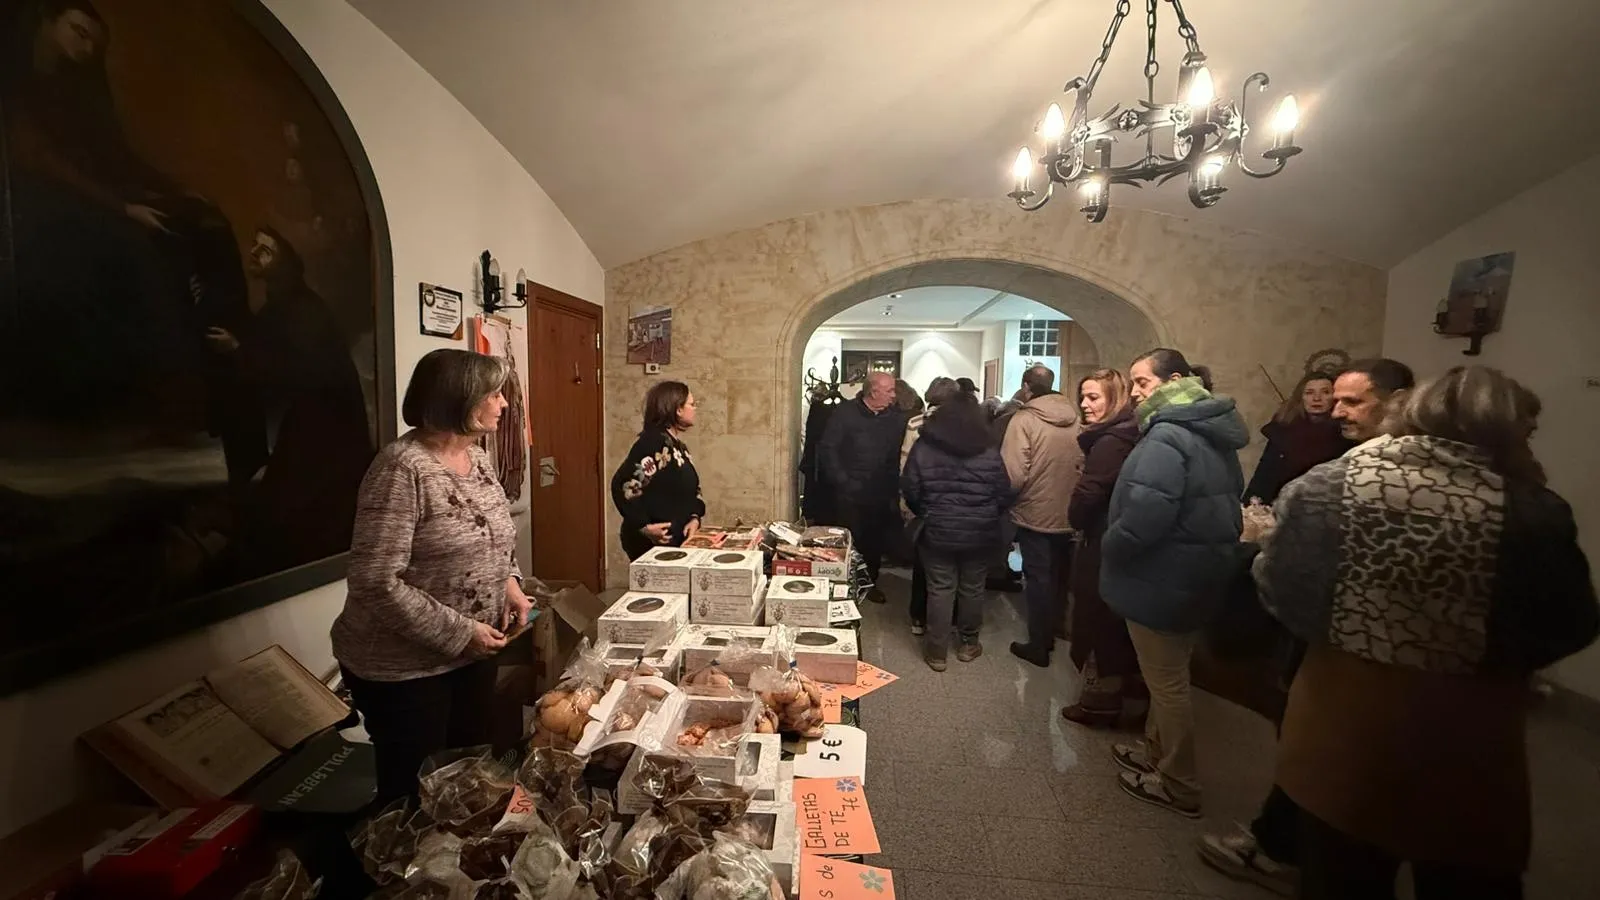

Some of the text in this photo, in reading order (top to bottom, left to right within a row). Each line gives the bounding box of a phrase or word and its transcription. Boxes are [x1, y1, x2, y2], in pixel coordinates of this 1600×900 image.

[842, 796, 859, 811] 7€
[801, 792, 827, 849] GALLETAS
[822, 810, 850, 847] DE TÉ
[815, 864, 833, 880] de
